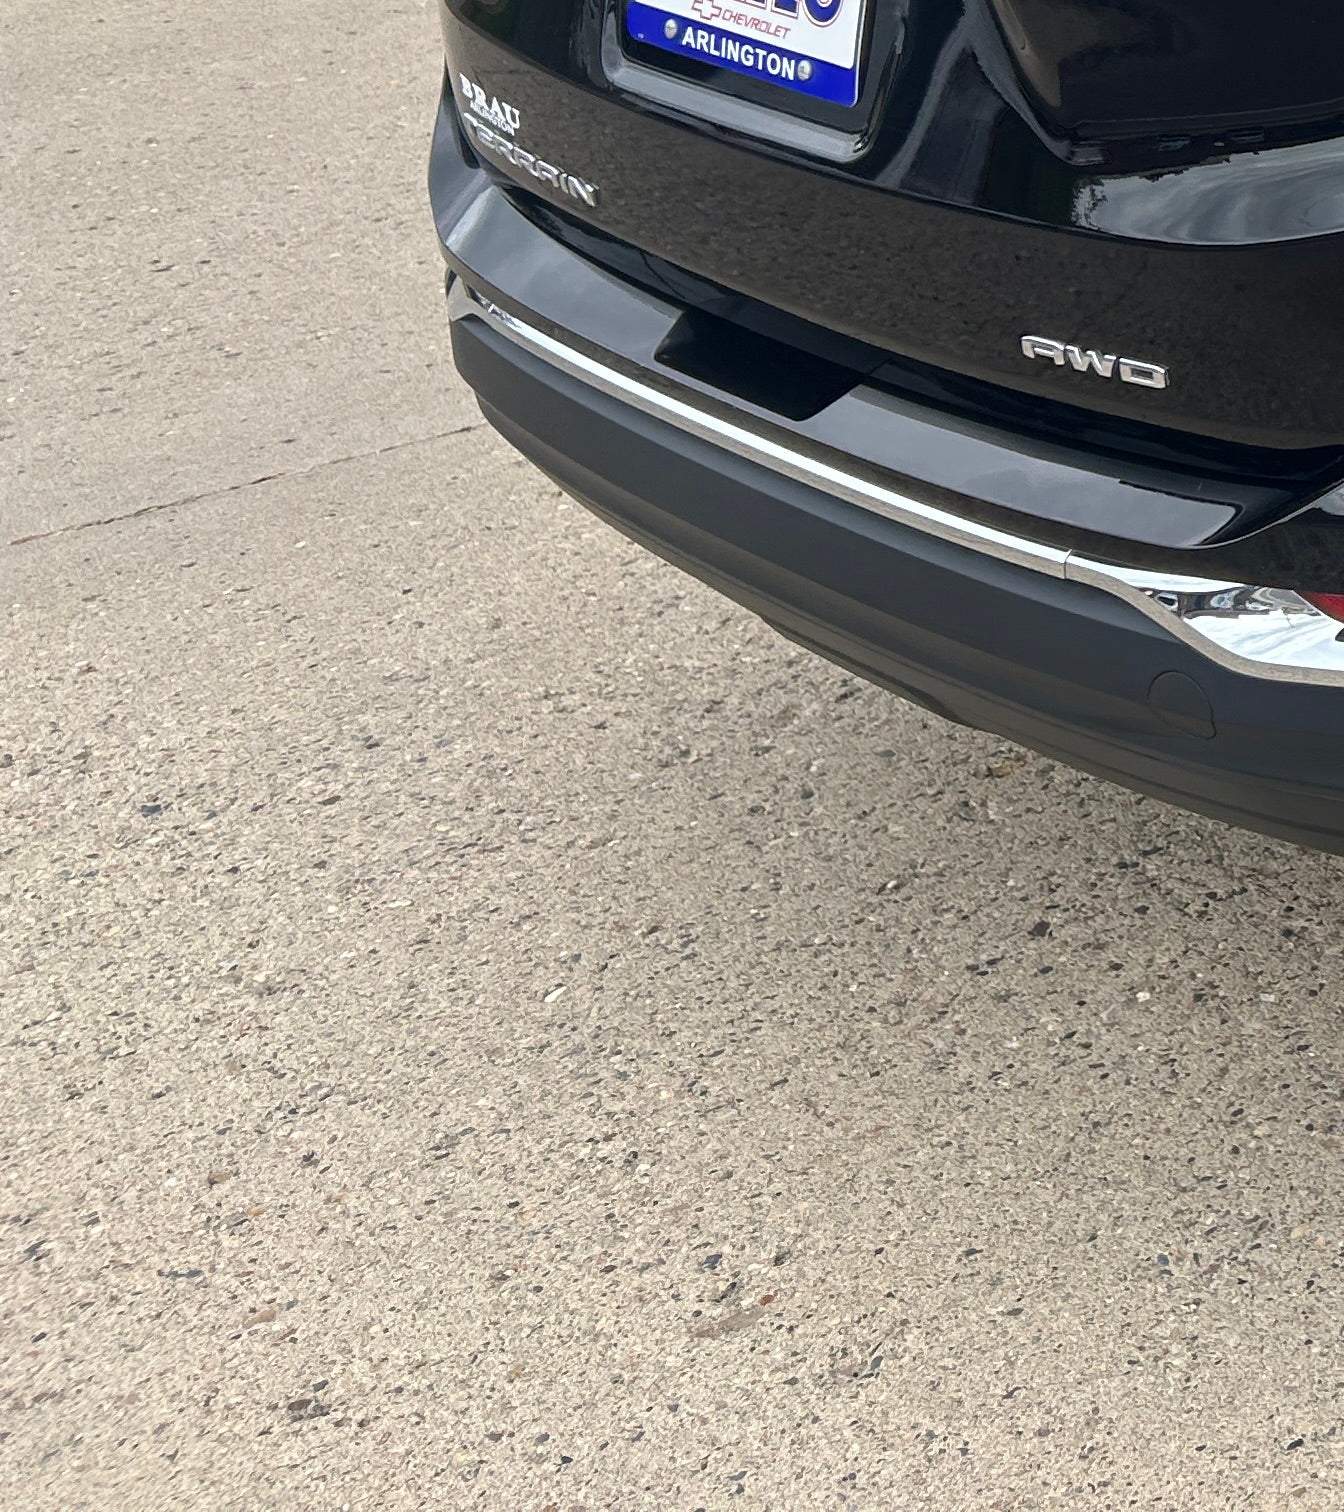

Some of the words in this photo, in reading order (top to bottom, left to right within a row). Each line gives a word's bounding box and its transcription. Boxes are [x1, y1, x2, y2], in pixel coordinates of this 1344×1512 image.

[722, 9, 791, 39] CHEVROLET
[682, 26, 796, 81] ARLINGTON
[459, 72, 520, 129] BRAU
[463, 112, 600, 207] TERRAIN
[1020, 335, 1170, 390] AWD
